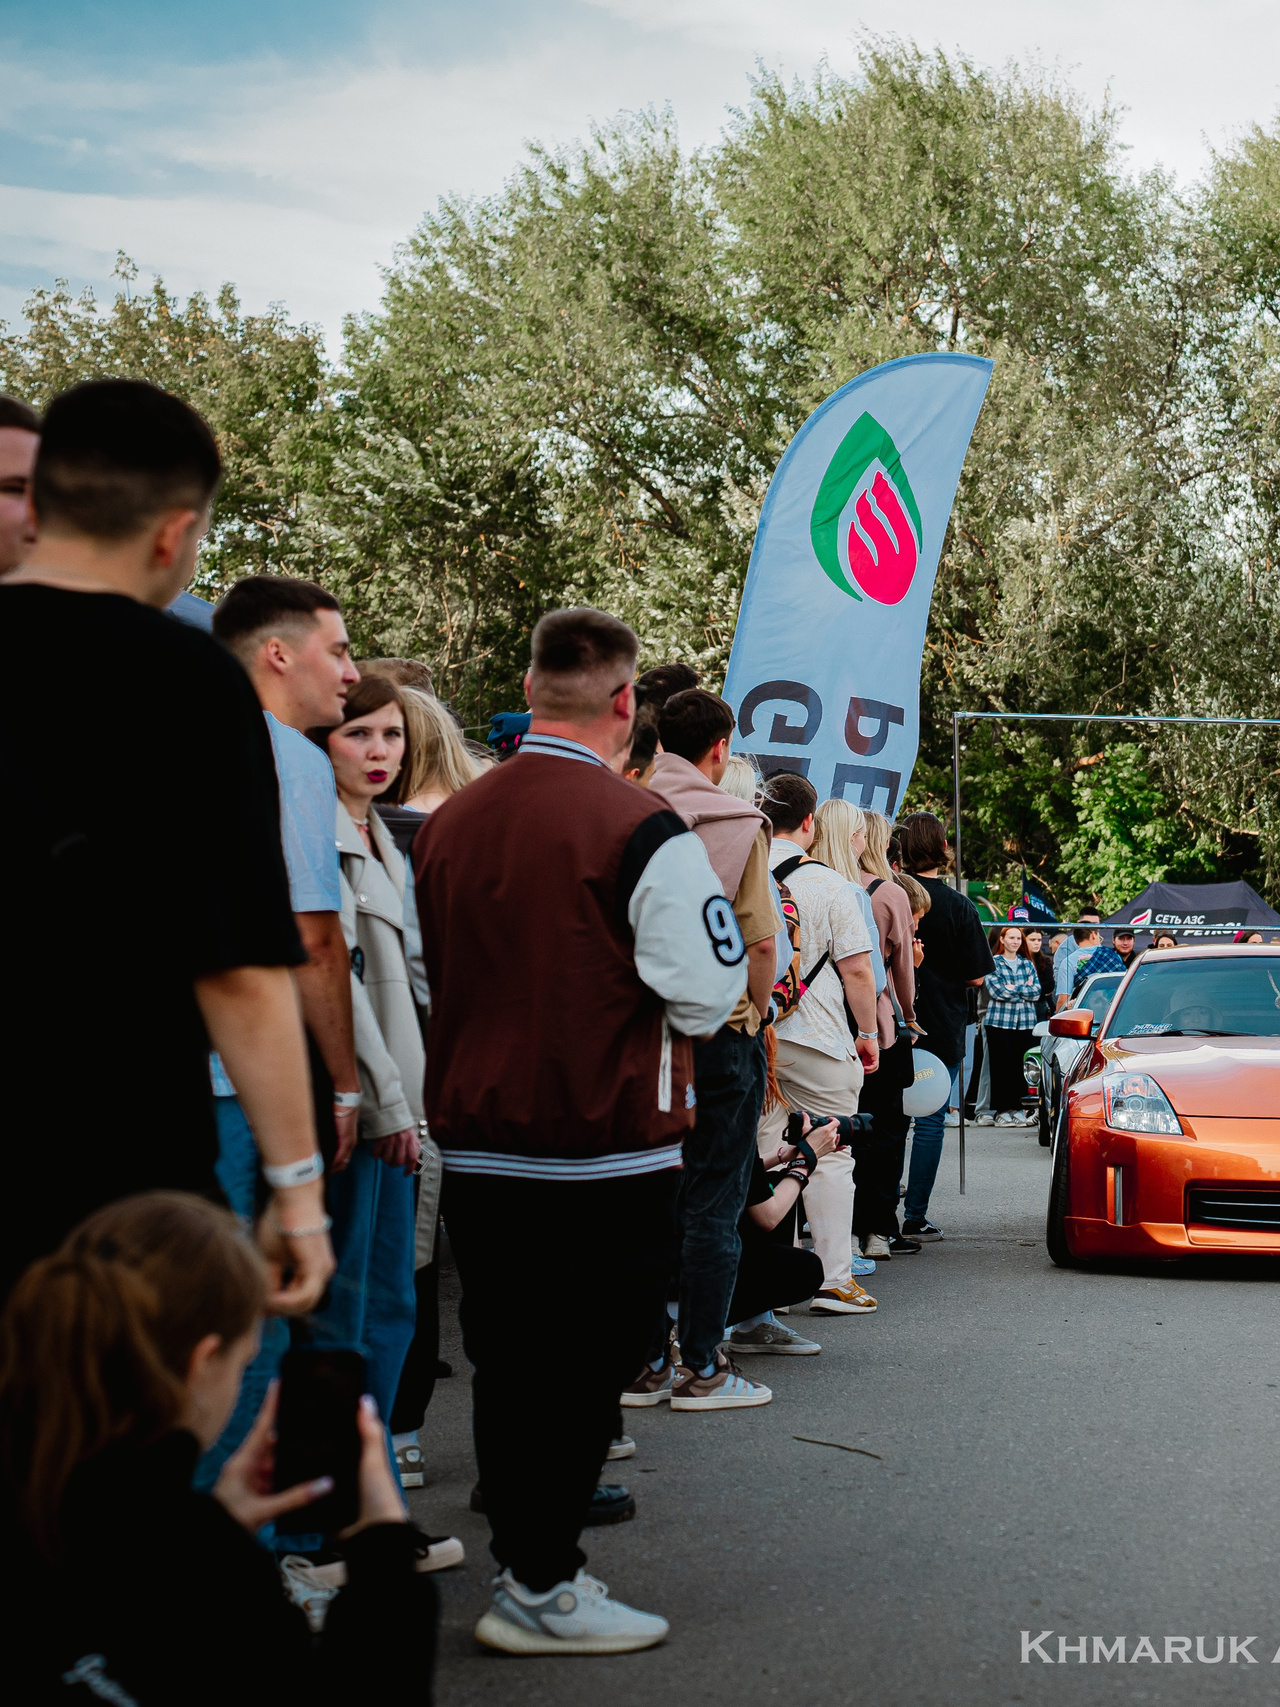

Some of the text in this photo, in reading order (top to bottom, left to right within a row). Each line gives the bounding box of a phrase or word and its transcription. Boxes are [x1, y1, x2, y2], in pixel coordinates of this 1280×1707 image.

[703, 895, 746, 967] 9
[1155, 914, 1206, 925] СЕТЬ АЗС
